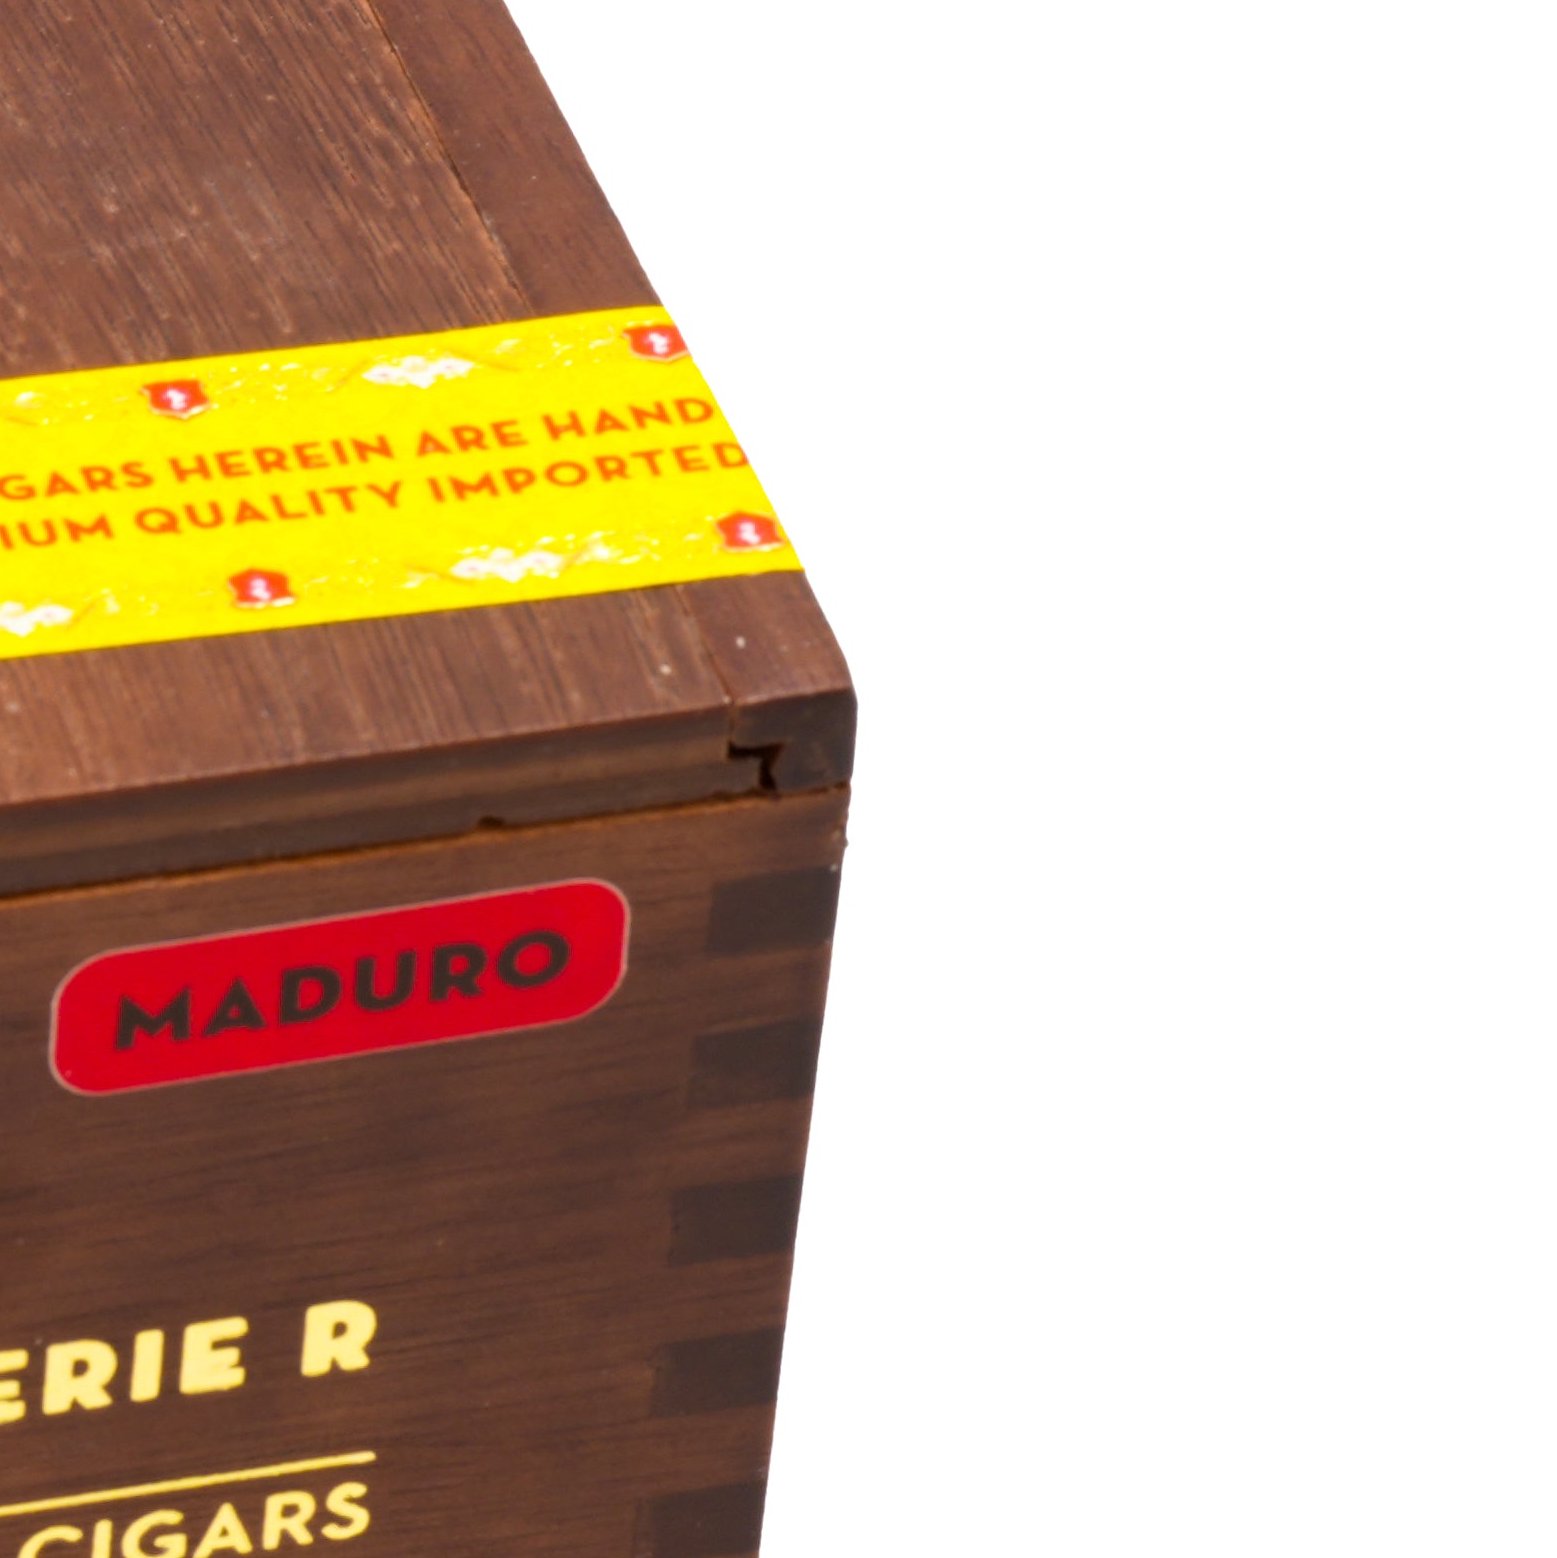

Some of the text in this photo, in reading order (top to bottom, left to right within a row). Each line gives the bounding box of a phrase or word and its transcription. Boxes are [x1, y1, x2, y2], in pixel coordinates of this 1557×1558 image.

[169, 435, 393, 482] HEREIN
[417, 421, 526, 456] ARE
[543, 398, 713, 440] HAND
[135, 481, 401, 534] QUALITY
[428, 443, 748, 502] IMPORTED
[116, 931, 570, 1049] MADURO
[301, 1301, 376, 1376] R
